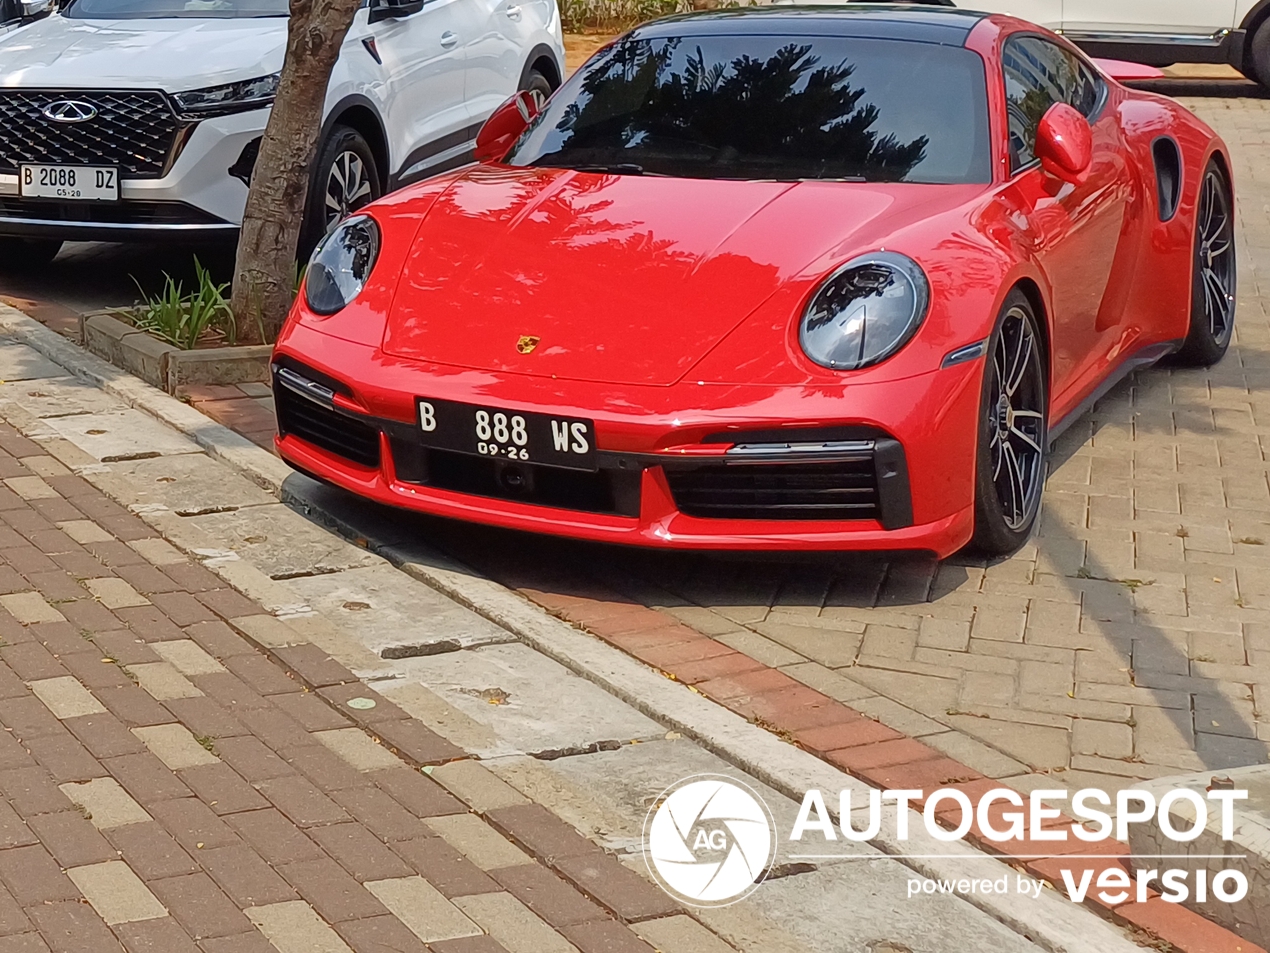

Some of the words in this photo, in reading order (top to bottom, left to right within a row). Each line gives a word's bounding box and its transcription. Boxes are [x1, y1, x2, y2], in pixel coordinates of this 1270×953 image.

[24, 167, 33, 185] B
[39, 168, 76, 187] 2088
[95, 170, 115, 189] DZ
[419, 401, 437, 432] B
[475, 410, 528, 446] 888
[550, 420, 589, 454] WS
